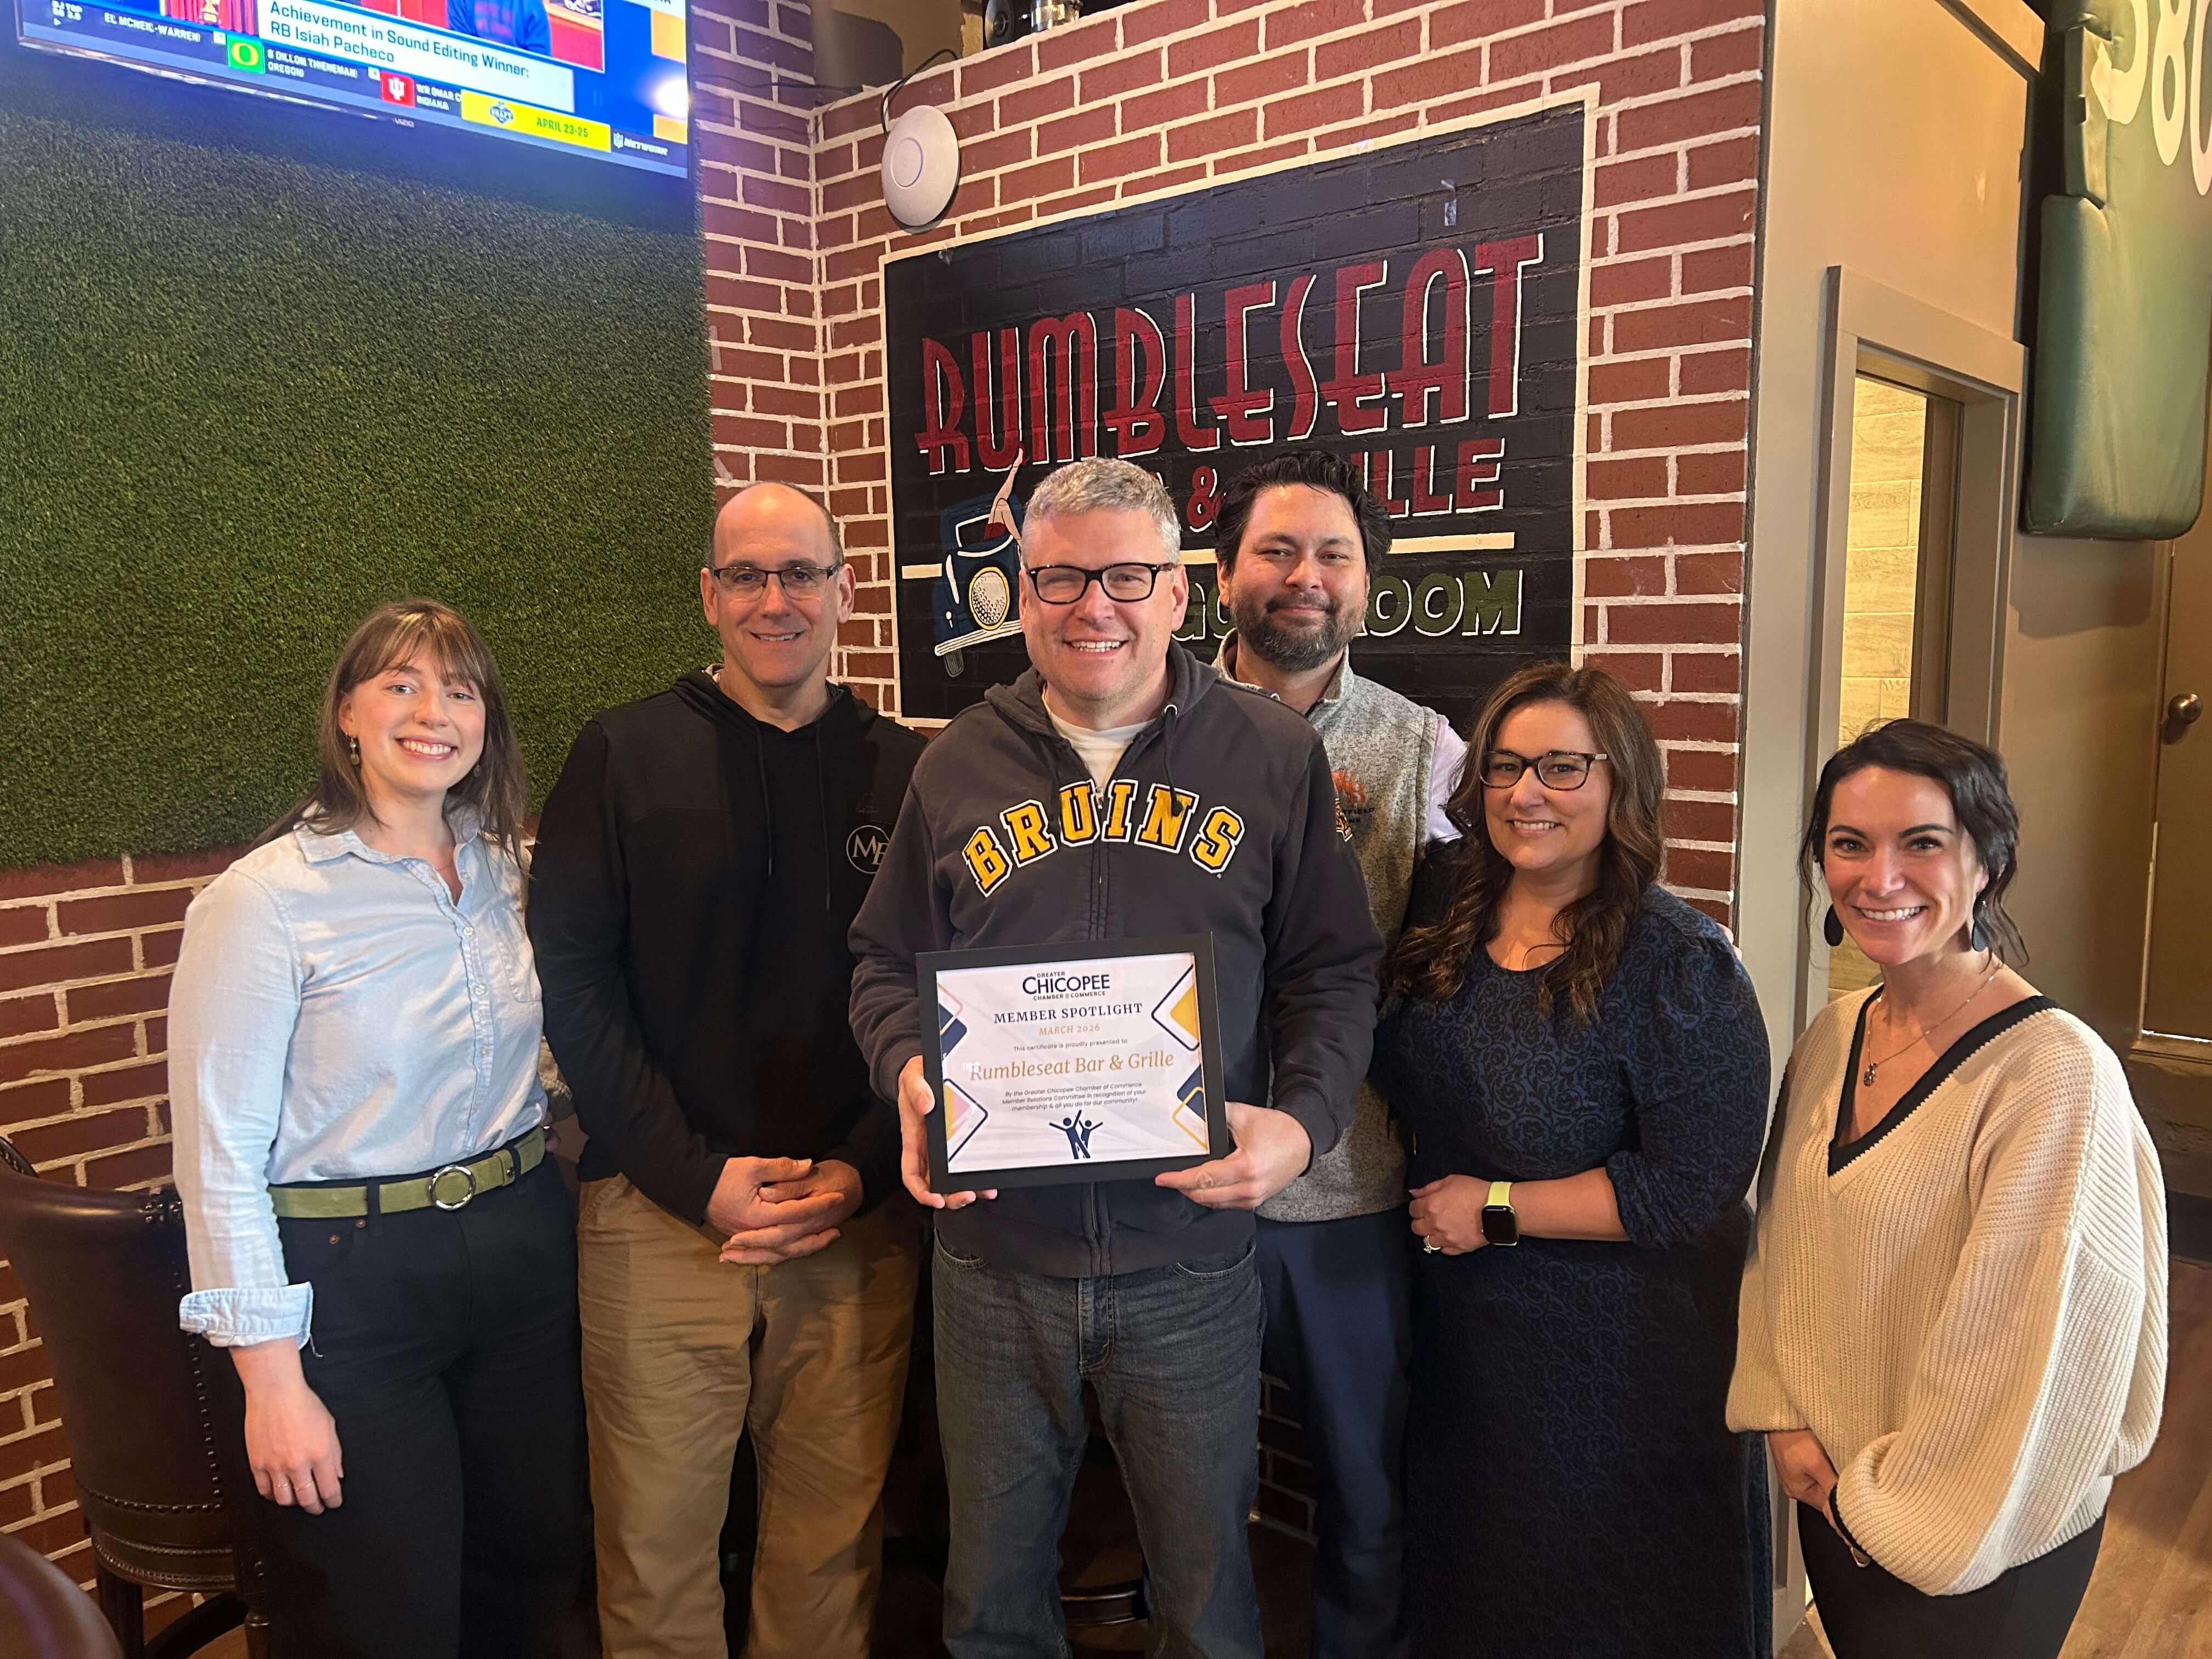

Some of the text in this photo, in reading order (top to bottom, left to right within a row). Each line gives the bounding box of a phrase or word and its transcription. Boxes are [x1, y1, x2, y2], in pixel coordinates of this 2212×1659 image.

[270, 1, 529, 77] Achievement in Sound Editing Winner:
[271, 21, 394, 62] RB Isiah Pacheco
[268, 61, 304, 77] OREGON
[417, 95, 449, 110] INDIANA
[537, 117, 589, 138] APRIL 23-25
[624, 137, 668, 156] NETWORK
[915, 233, 1544, 476] RUMBLESEAT
[1187, 437, 1505, 533] & ILLE
[1363, 569, 1523, 638] OOM
[961, 778, 1245, 898] BRUINS
[1022, 974, 1110, 995] CHICOPEE
[994, 1003, 1143, 1024] MEMBER SPOTLIGHT
[1038, 1023, 1101, 1036] MARCH 2026
[1065, 1040, 1088, 1049] proudly
[969, 1050, 1174, 1081] Rumbleseat Bar & Grille
